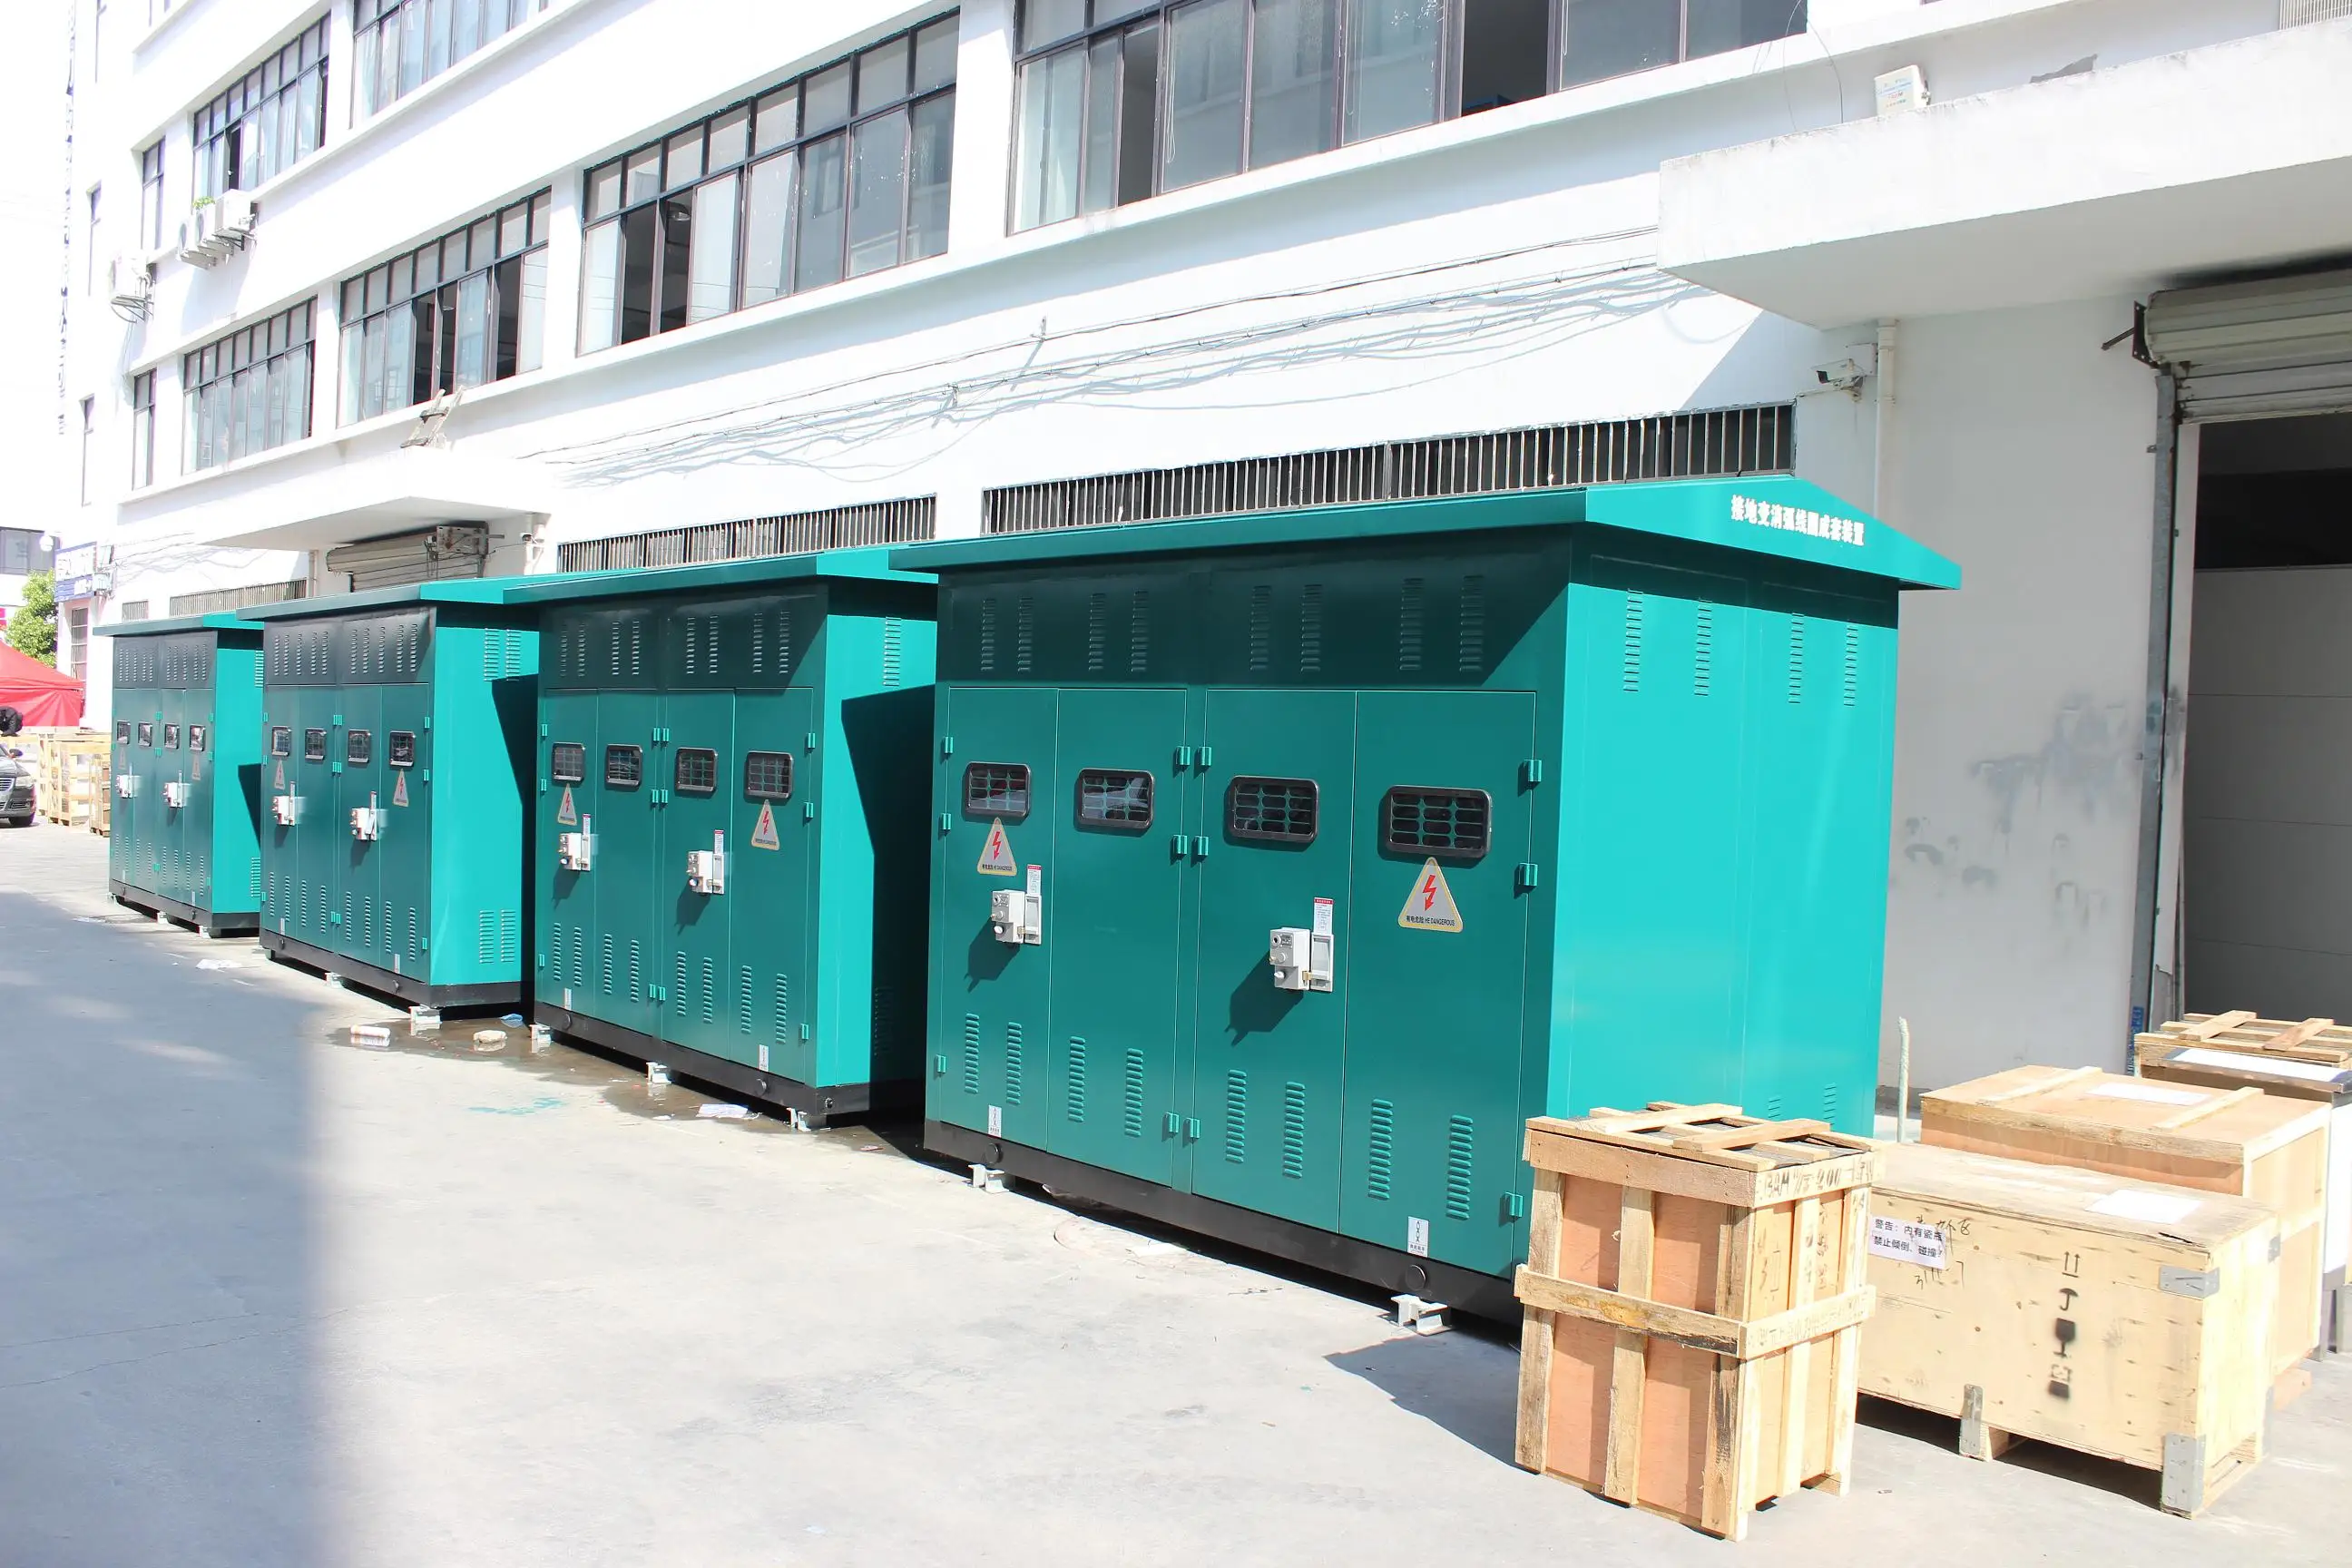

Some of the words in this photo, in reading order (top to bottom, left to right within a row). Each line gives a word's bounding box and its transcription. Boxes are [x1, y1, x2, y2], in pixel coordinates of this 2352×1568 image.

[1730, 494, 1865, 546] 接地变消弧线圈成套装置
[1431, 917, 1455, 926] DANGEROUS
